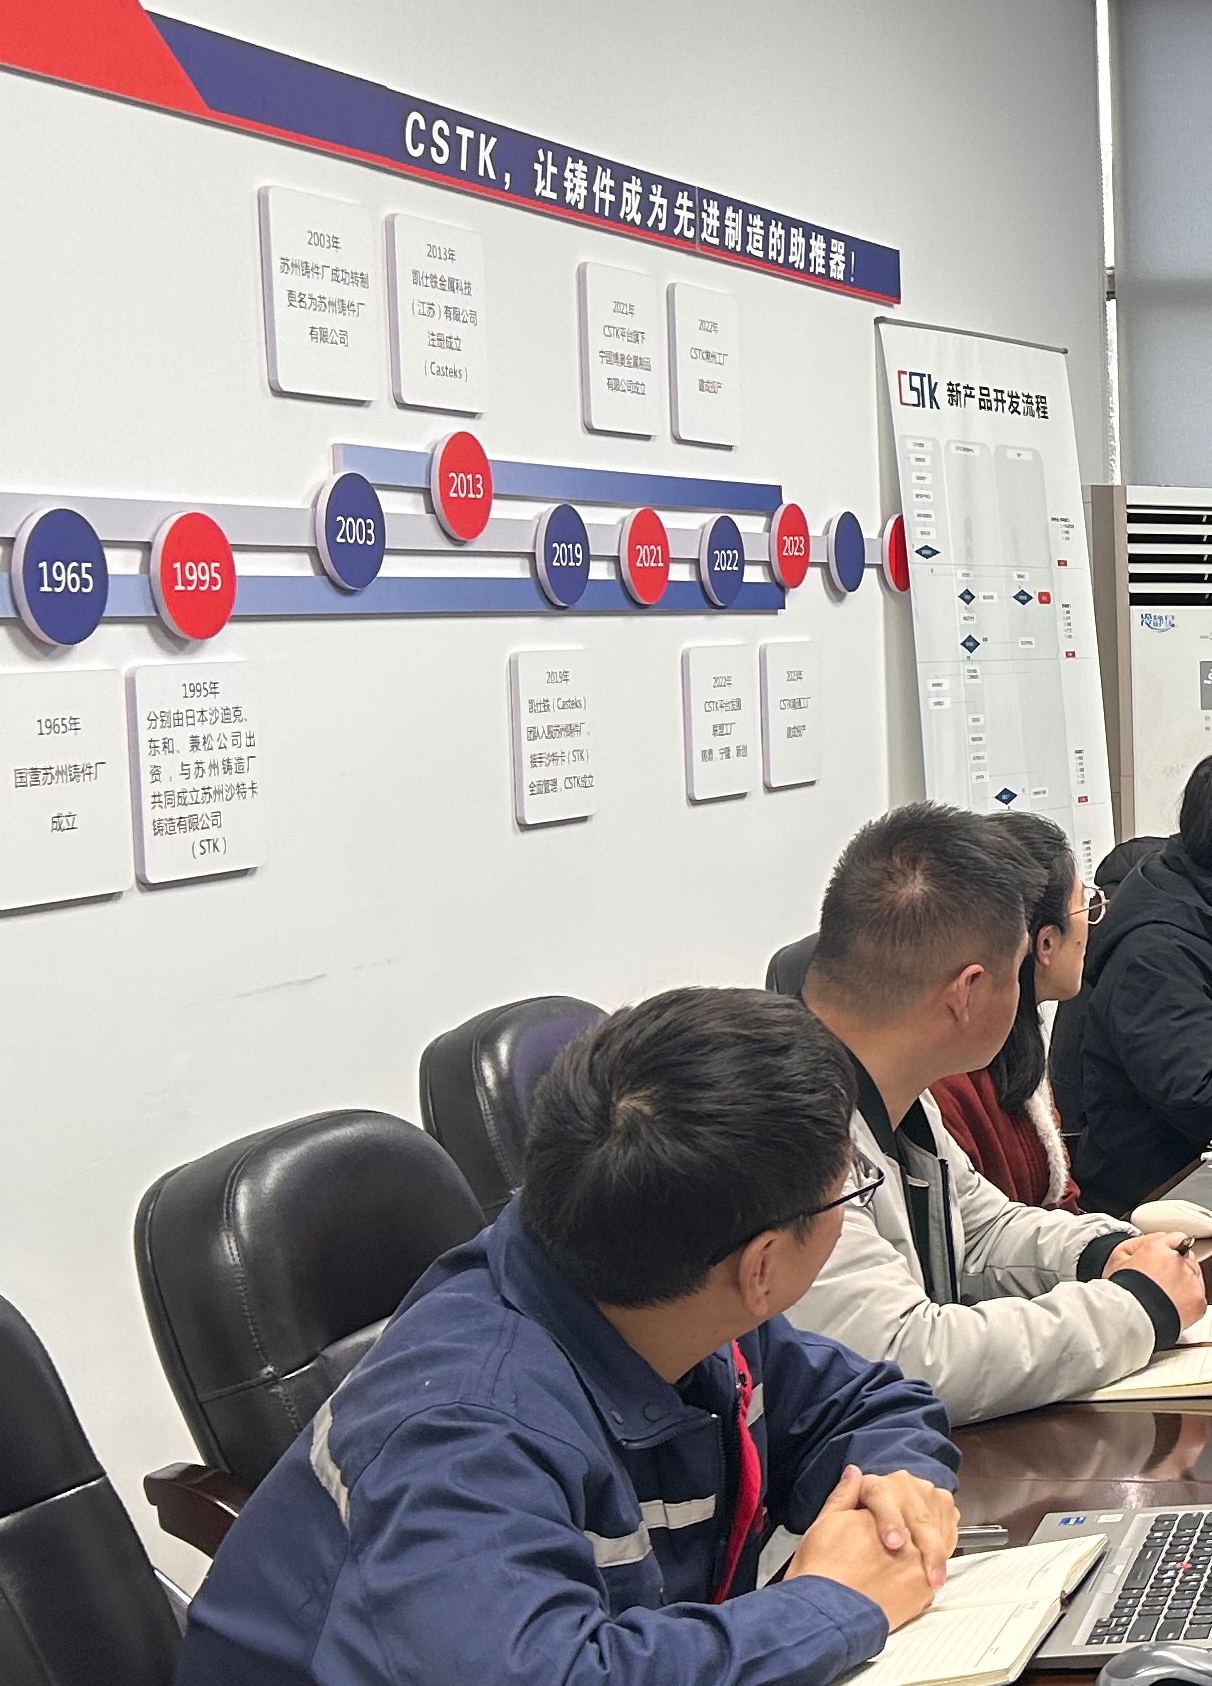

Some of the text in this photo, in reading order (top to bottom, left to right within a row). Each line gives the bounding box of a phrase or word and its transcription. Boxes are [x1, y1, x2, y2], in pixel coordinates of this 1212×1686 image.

[307, 230, 342, 253] 2003年
[427, 244, 456, 263] 2013年
[309, 326, 349, 347] 有限公司
[946, 380, 1049, 420] 新产品开发流程
[449, 472, 484, 499] 2013
[336, 516, 376, 546] 2003
[552, 541, 583, 568] 2019
[635, 544, 664, 568] 2021
[782, 536, 805, 557] 2023
[713, 548, 739, 572] 2022
[38, 560, 94, 593] 1965
[172, 561, 223, 592] 1995
[182, 681, 220, 699] 1995年
[37, 716, 82, 736] 1965年
[14, 761, 106, 788] 国营苏州铸件厂
[150, 780, 258, 810] 共同成立苏州沙特卡
[51, 811, 78, 833] 成立
[152, 811, 222, 837] 铸造有限公司
